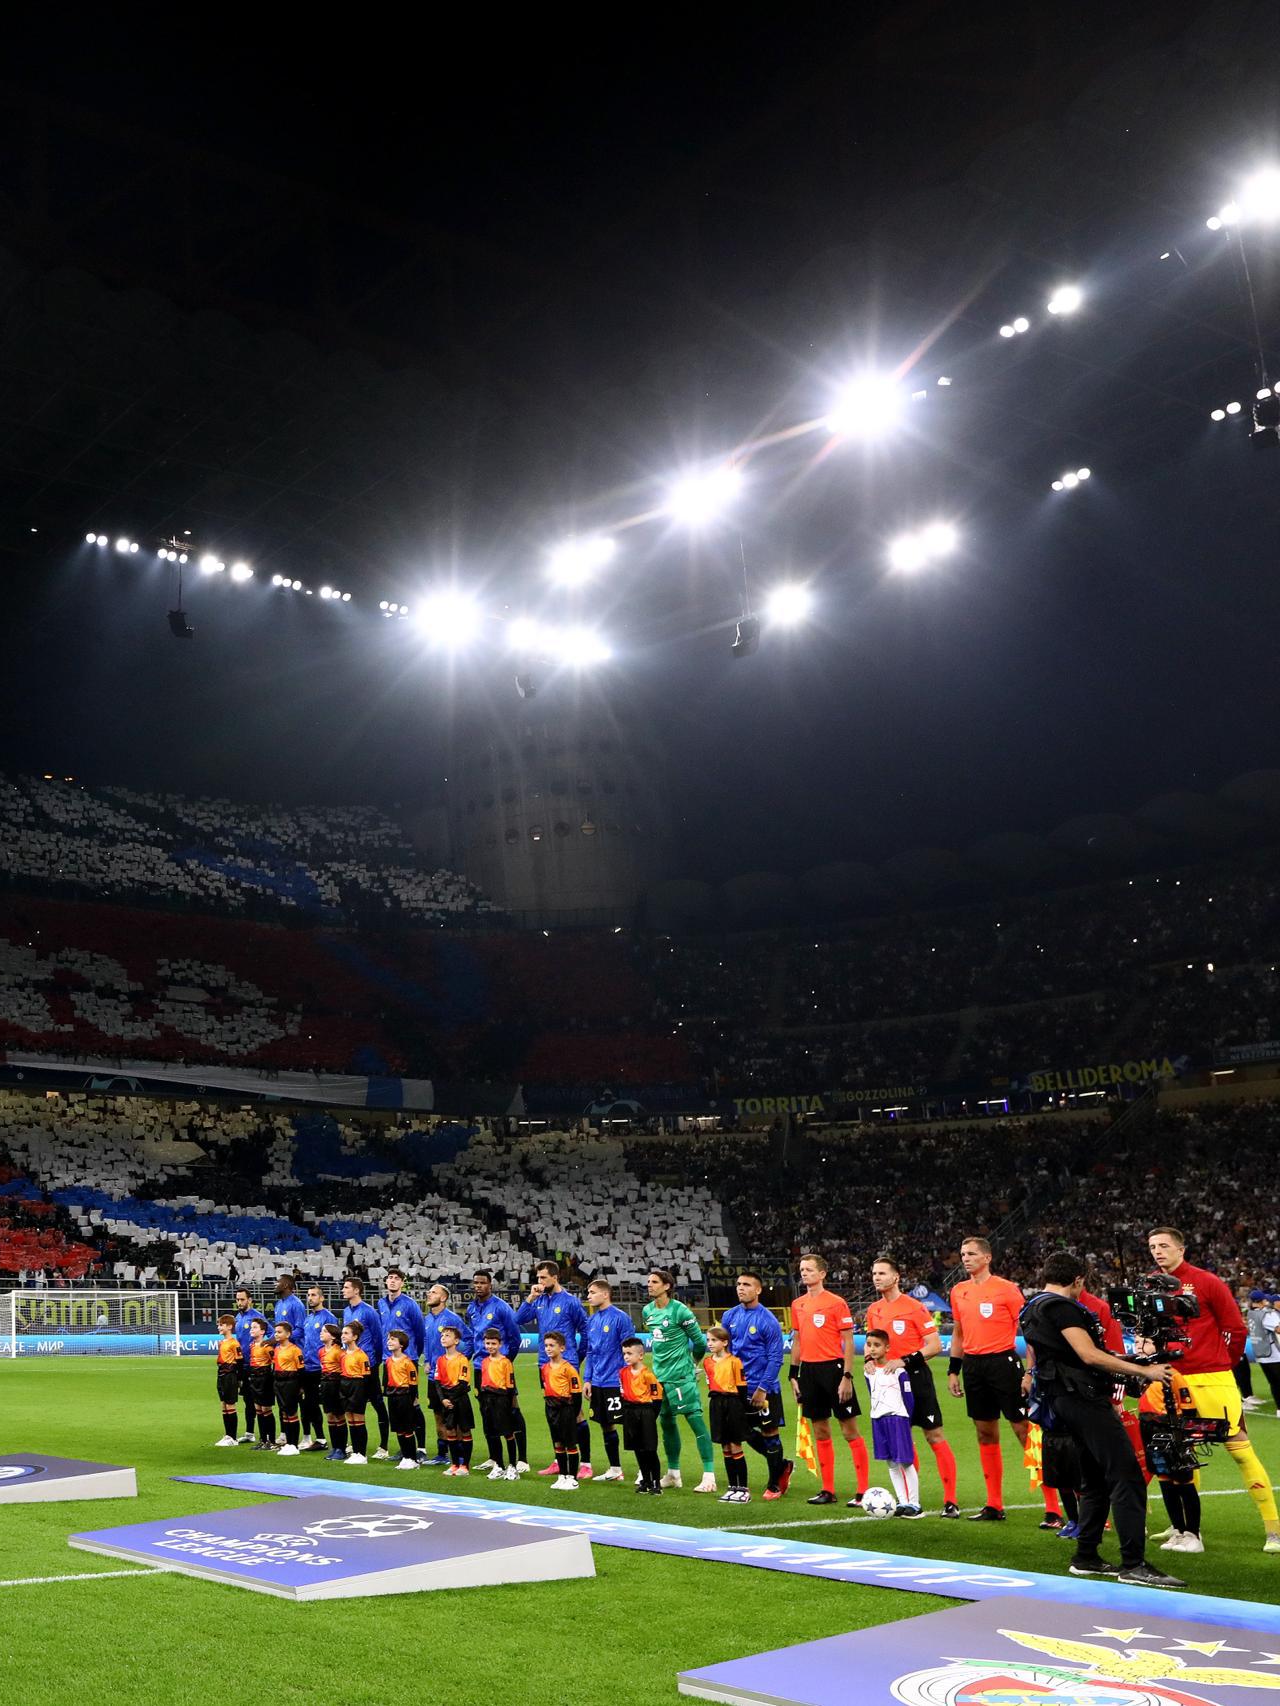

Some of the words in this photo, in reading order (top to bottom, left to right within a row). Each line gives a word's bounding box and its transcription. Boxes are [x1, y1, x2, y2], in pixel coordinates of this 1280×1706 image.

[733, 1095, 824, 1116] TORRITA
[607, 1397, 622, 1411] 23
[675, 1388, 683, 1401] 1
[151, 1540, 275, 1566] LEAGUE
[164, 1529, 344, 1566] CHAMPIONS
